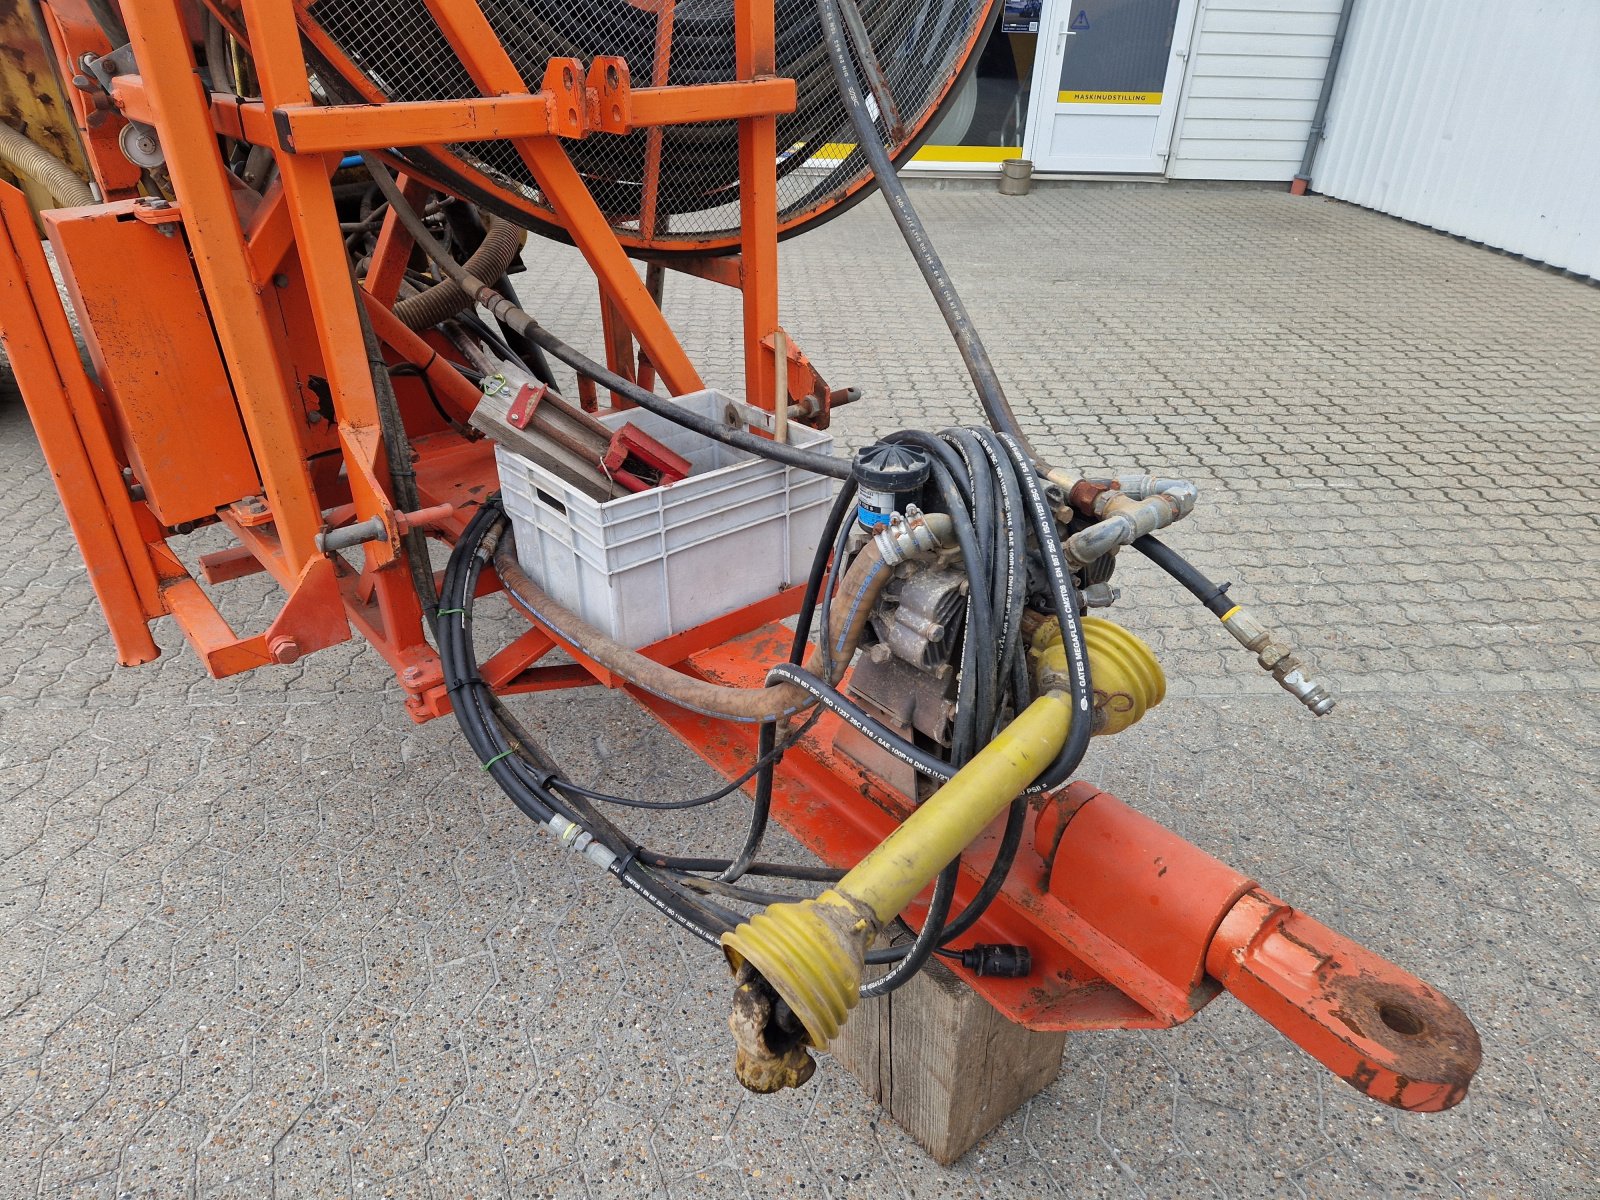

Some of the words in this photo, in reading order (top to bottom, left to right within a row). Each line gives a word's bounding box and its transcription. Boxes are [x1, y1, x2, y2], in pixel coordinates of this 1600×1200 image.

[1074, 93, 1146, 101] MASKINUDSTILLING
[1020, 461, 1029, 473] SAE
[1026, 476, 1035, 488] R16
[1030, 488, 1040, 501] 2SC
[1035, 502, 1046, 520] 11237
[1041, 521, 1050, 534] ISO
[1047, 539, 1056, 553] 2SC
[1051, 554, 1060, 566] 857
[1055, 567, 1063, 578] EN
[1059, 585, 1072, 613] CM2T08
[1067, 618, 1082, 660] MEGAFLEX
[1076, 661, 1086, 687] GATES
[809, 686, 820, 697] 2SC
[823, 696, 833, 707] ISO
[834, 705, 850, 719] 11237
[849, 717, 862, 728] 2SC
[862, 726, 874, 737] R16
[877, 737, 891, 750] SAE
[891, 747, 913, 764] 100R16
[914, 761, 932, 774] DN12
[667, 908, 675, 916] ISO
[675, 913, 687, 923] 11237
